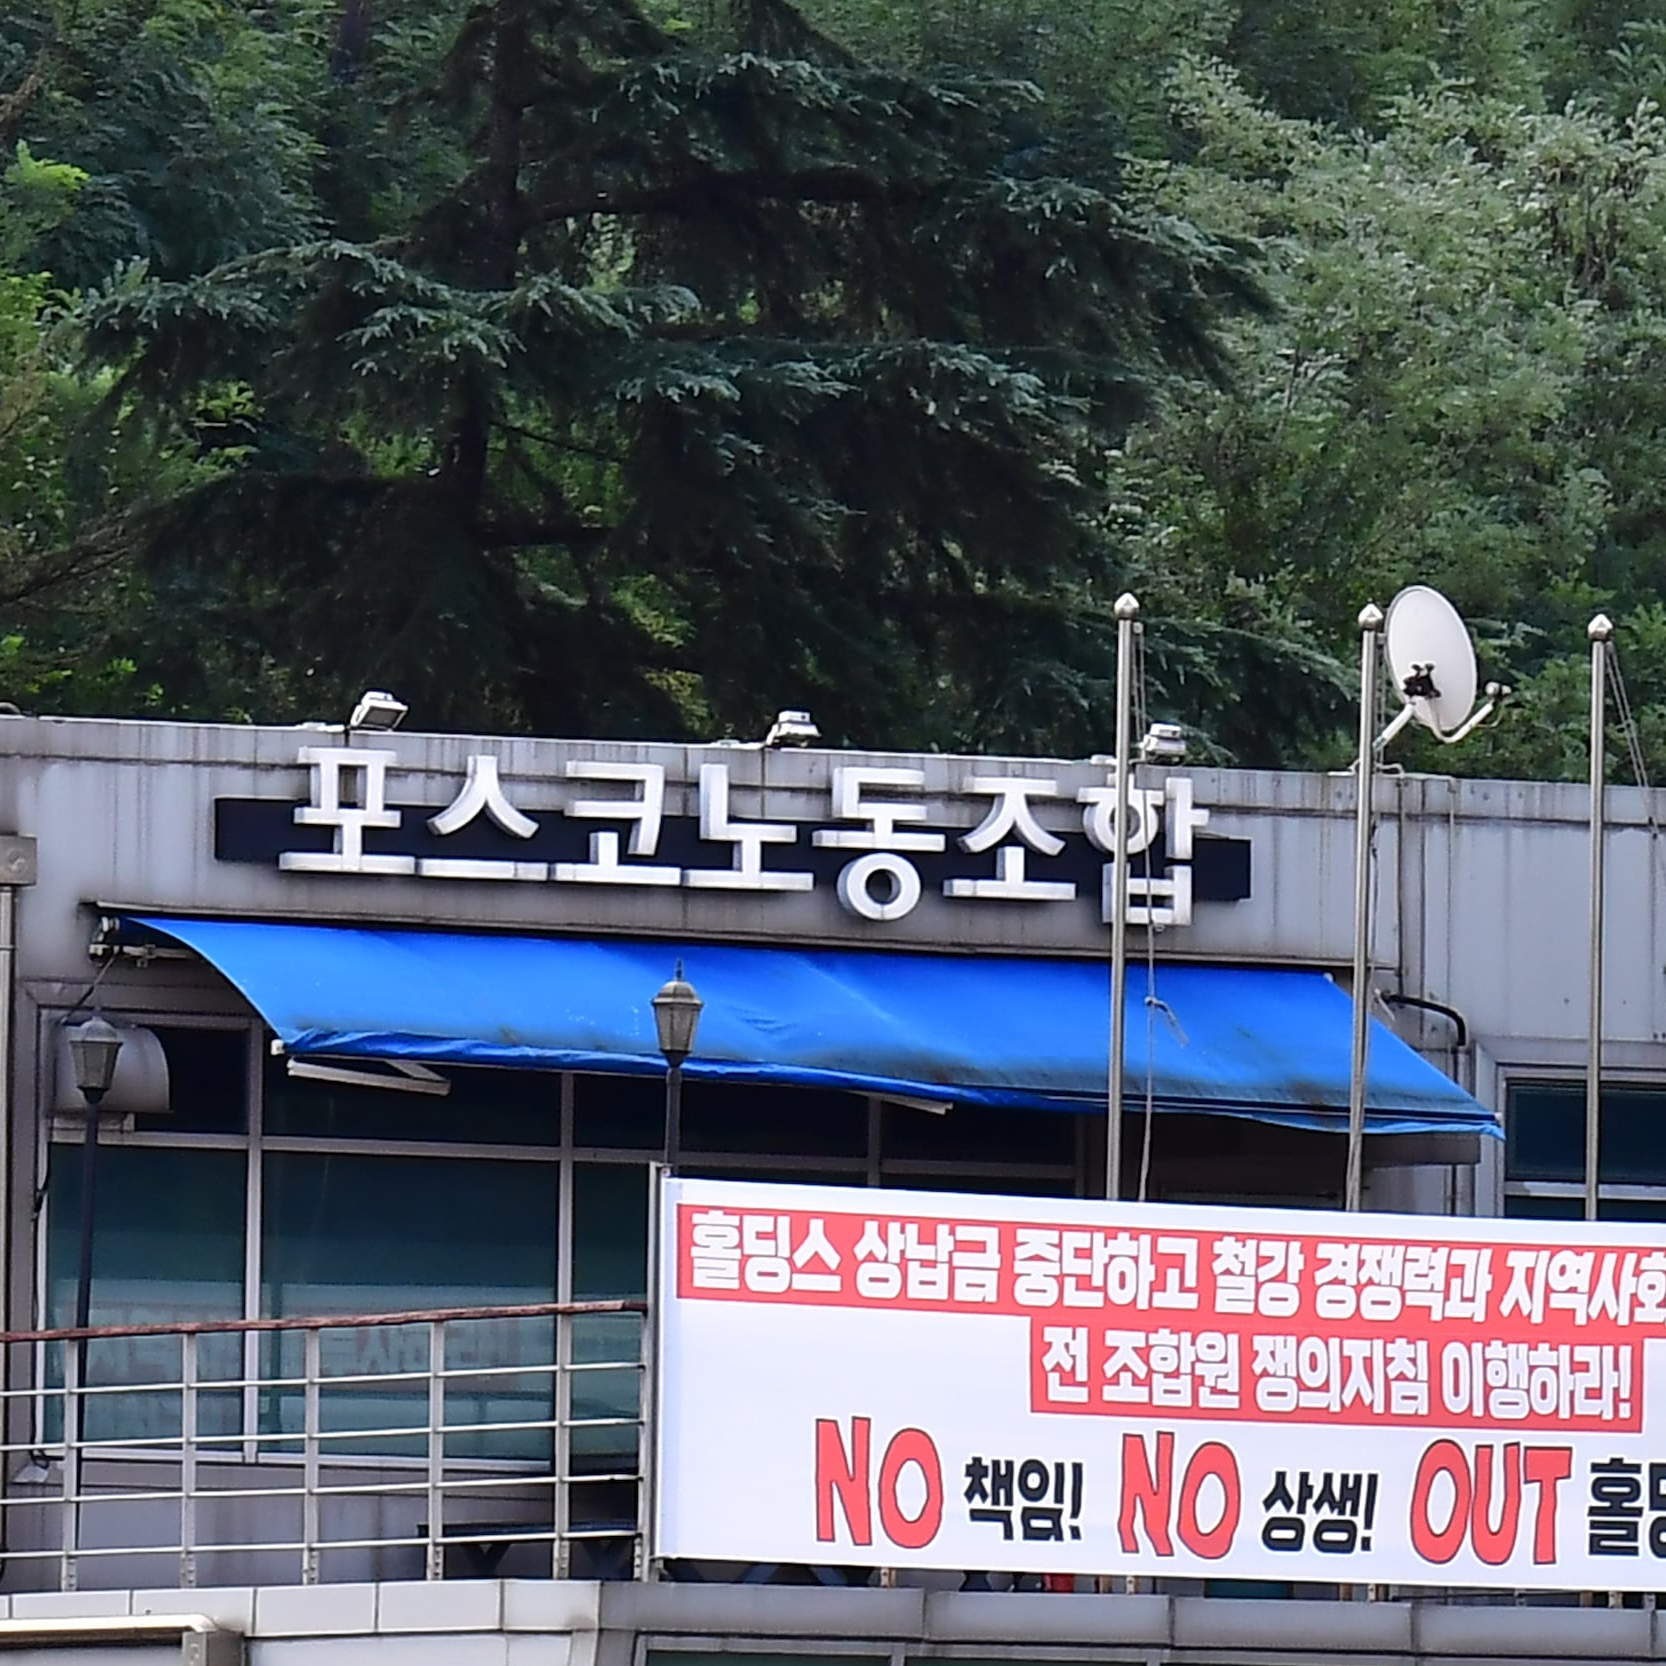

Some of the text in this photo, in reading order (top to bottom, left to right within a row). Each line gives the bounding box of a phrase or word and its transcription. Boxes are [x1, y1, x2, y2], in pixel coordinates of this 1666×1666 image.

[278, 746, 1208, 928] 포스코노동조합
[691, 1210, 842, 1293] 홀딩스
[853, 1220, 1002, 1303] 상납금
[1013, 1227, 1200, 1310] 중단하고
[1212, 1236, 1305, 1317] 철강
[1314, 1243, 1493, 1322] 경쟁력과
[1042, 1326, 1632, 1420] 전 조합원 쟁의지침 이행하라!
[815, 1416, 944, 1550] NO
[964, 1456, 1084, 1542] 책임!
[1118, 1431, 1242, 1560] NO
[1262, 1471, 1379, 1552] 상생!
[1410, 1438, 1574, 1566] OUT
